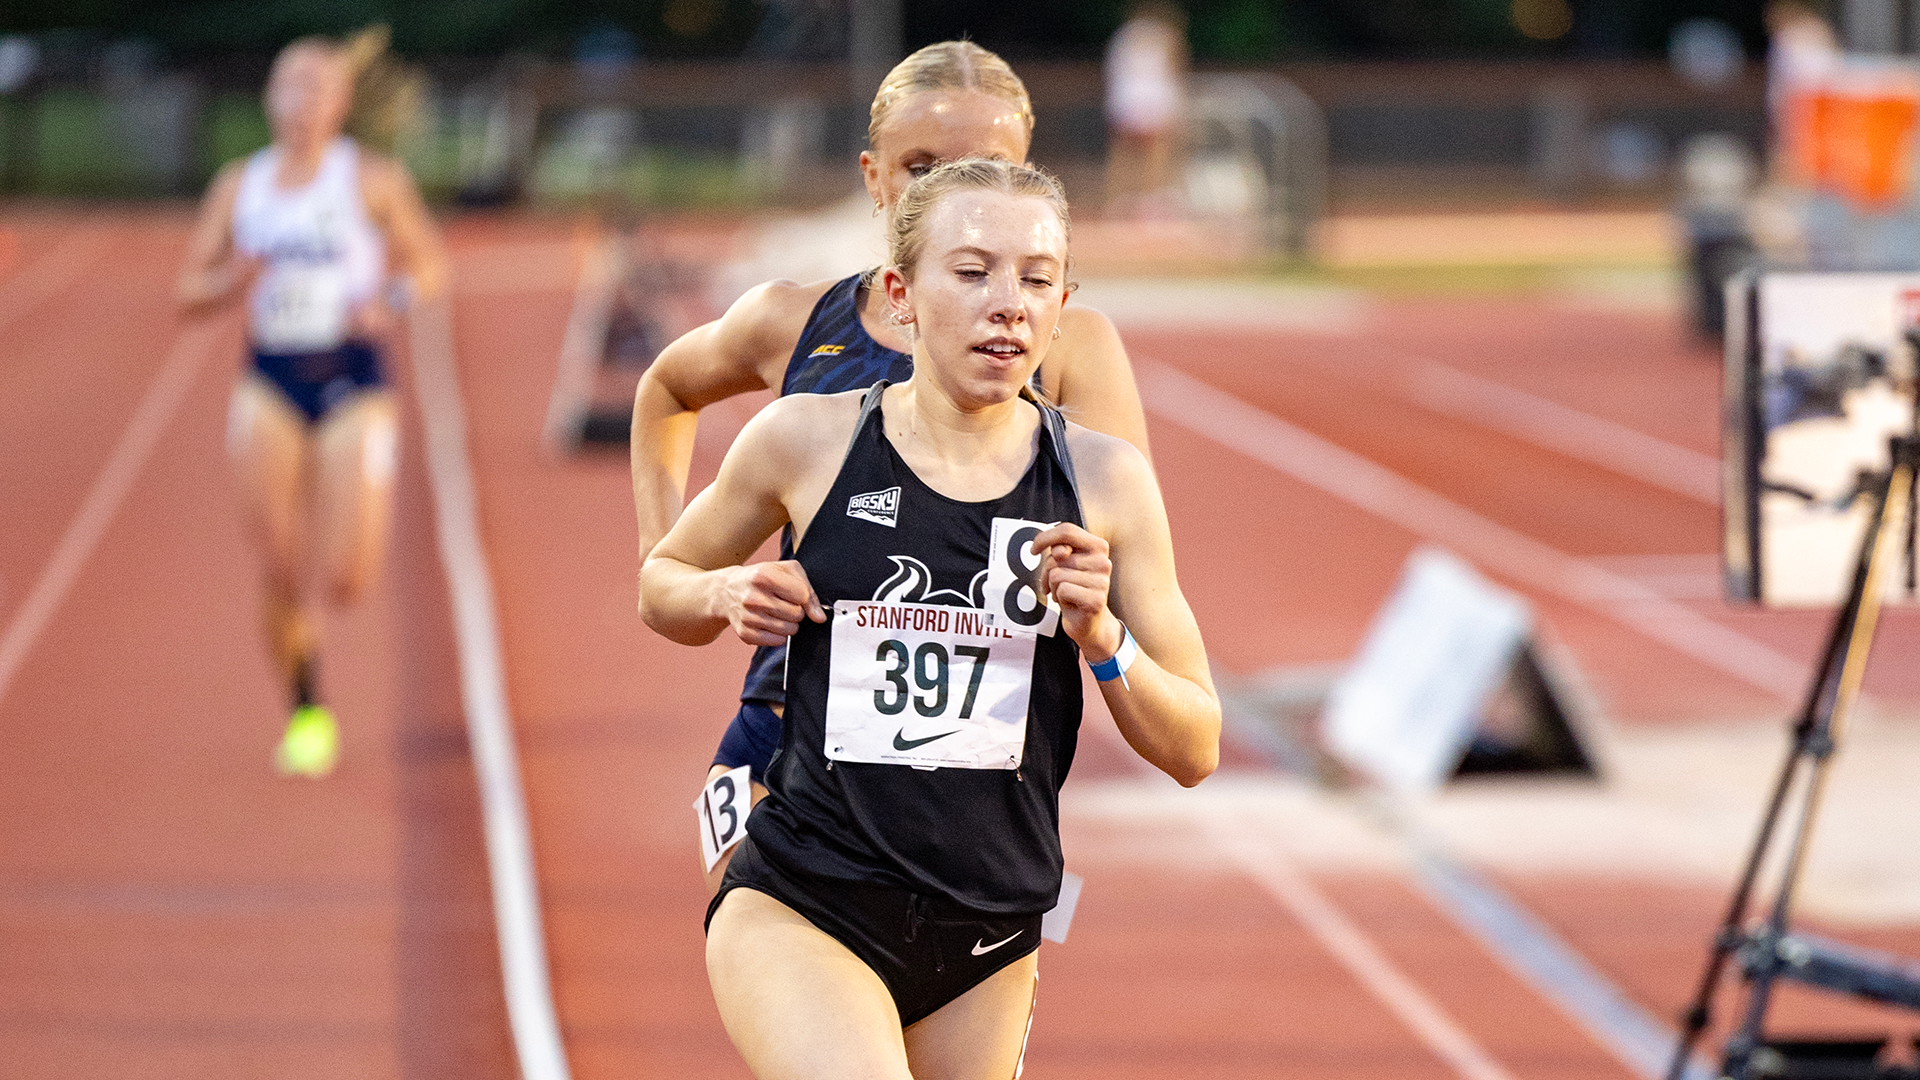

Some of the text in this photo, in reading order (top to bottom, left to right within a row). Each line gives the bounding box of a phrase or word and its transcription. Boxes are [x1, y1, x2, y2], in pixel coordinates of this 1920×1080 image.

[812, 344, 846, 355] ACC
[1005, 527, 1048, 626] 8
[856, 605, 949, 633] STANFORD
[873, 639, 991, 720] 397
[704, 776, 738, 854] 13
